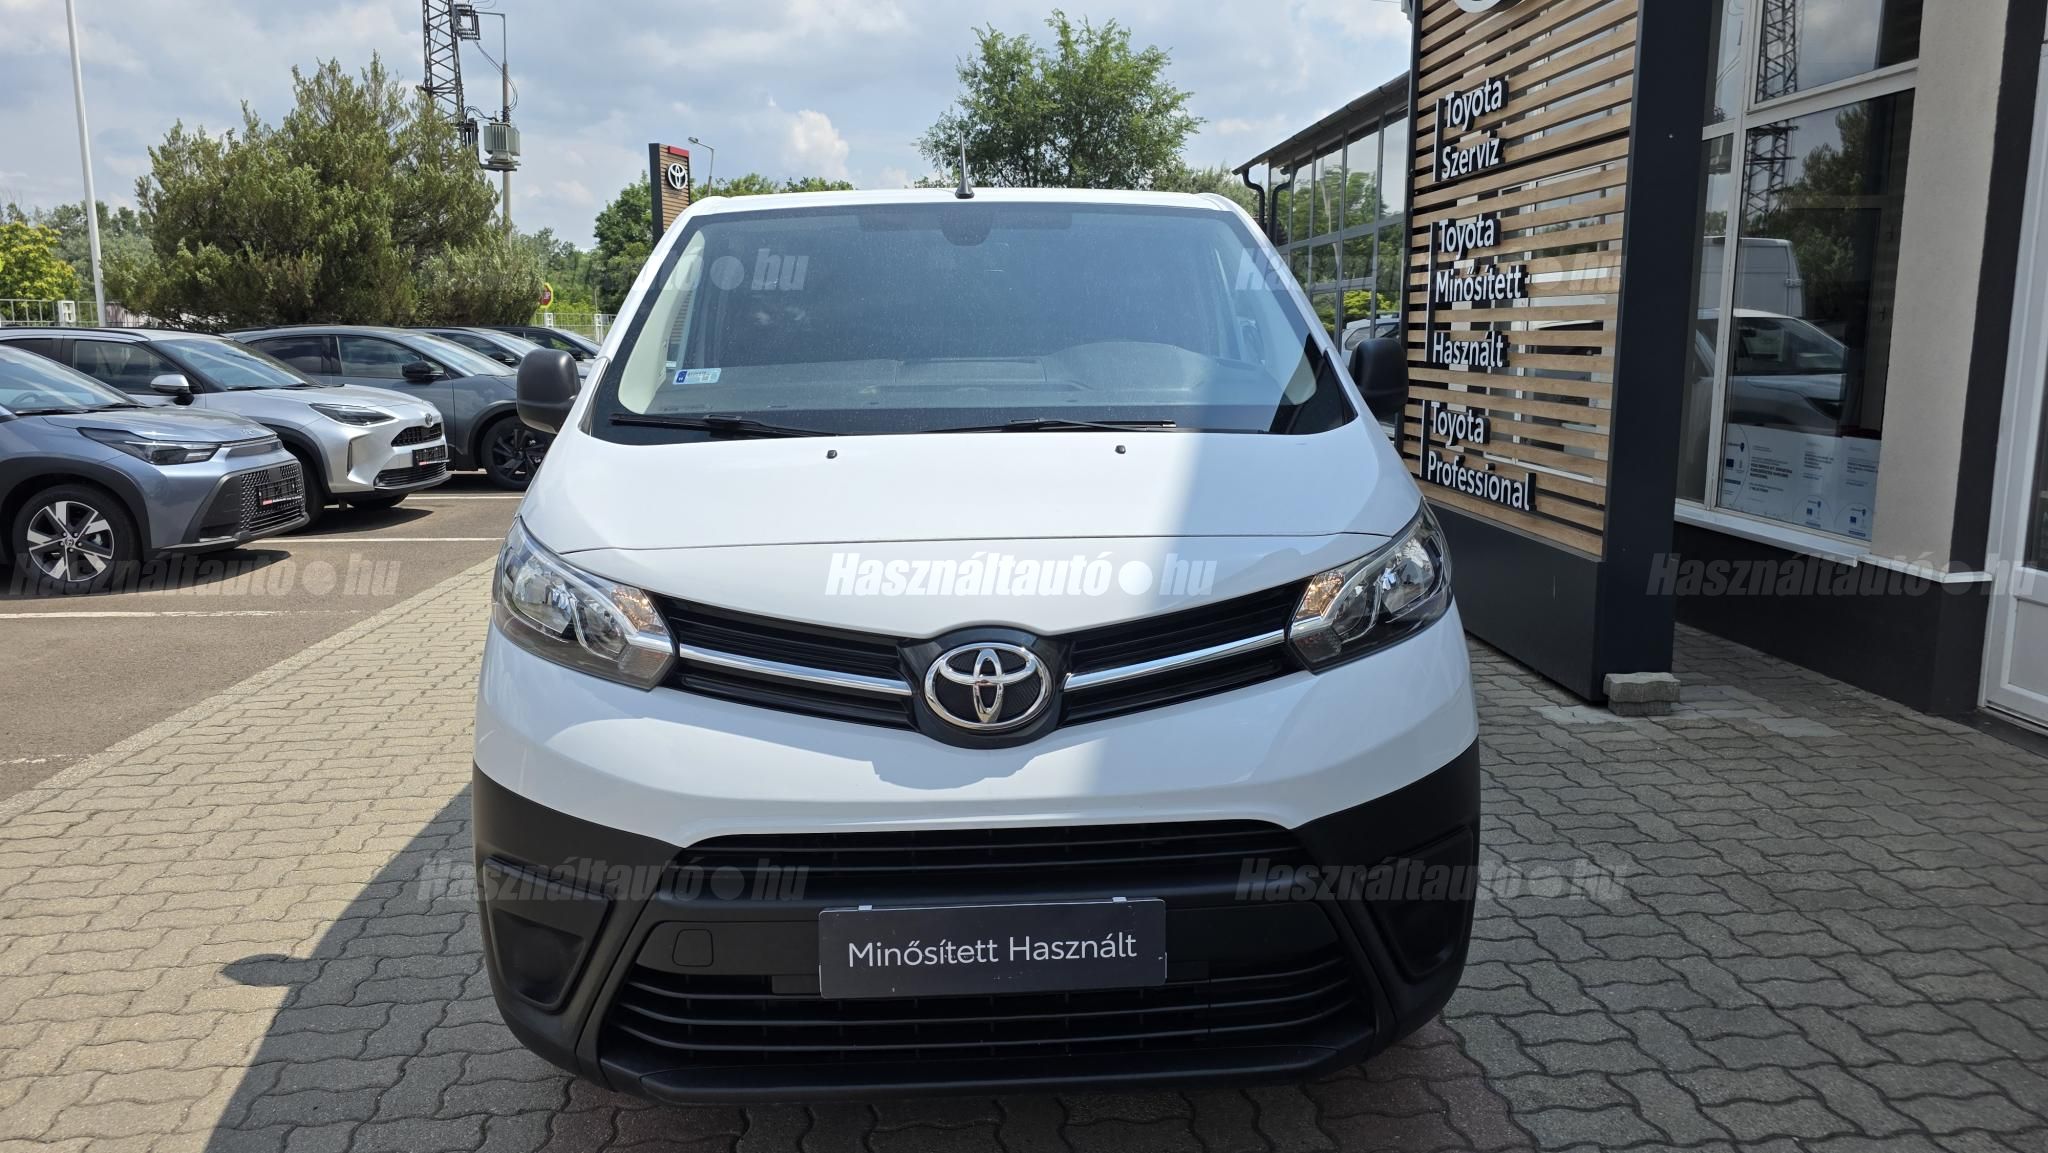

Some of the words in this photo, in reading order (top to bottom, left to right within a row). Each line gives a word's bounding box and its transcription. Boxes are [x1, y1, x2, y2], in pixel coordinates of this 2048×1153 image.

[1444, 78, 1502, 131] Toyota
[1441, 131, 1500, 179] Szerviz
[1438, 216, 1495, 260] Toyota
[1435, 265, 1523, 303] Minősített
[1432, 331, 1505, 368] Használt
[1430, 402, 1485, 446] Toyota
[1427, 451, 1530, 511] Professional
[848, 938, 1000, 968] Minősített
[1008, 931, 1137, 962] Használt
